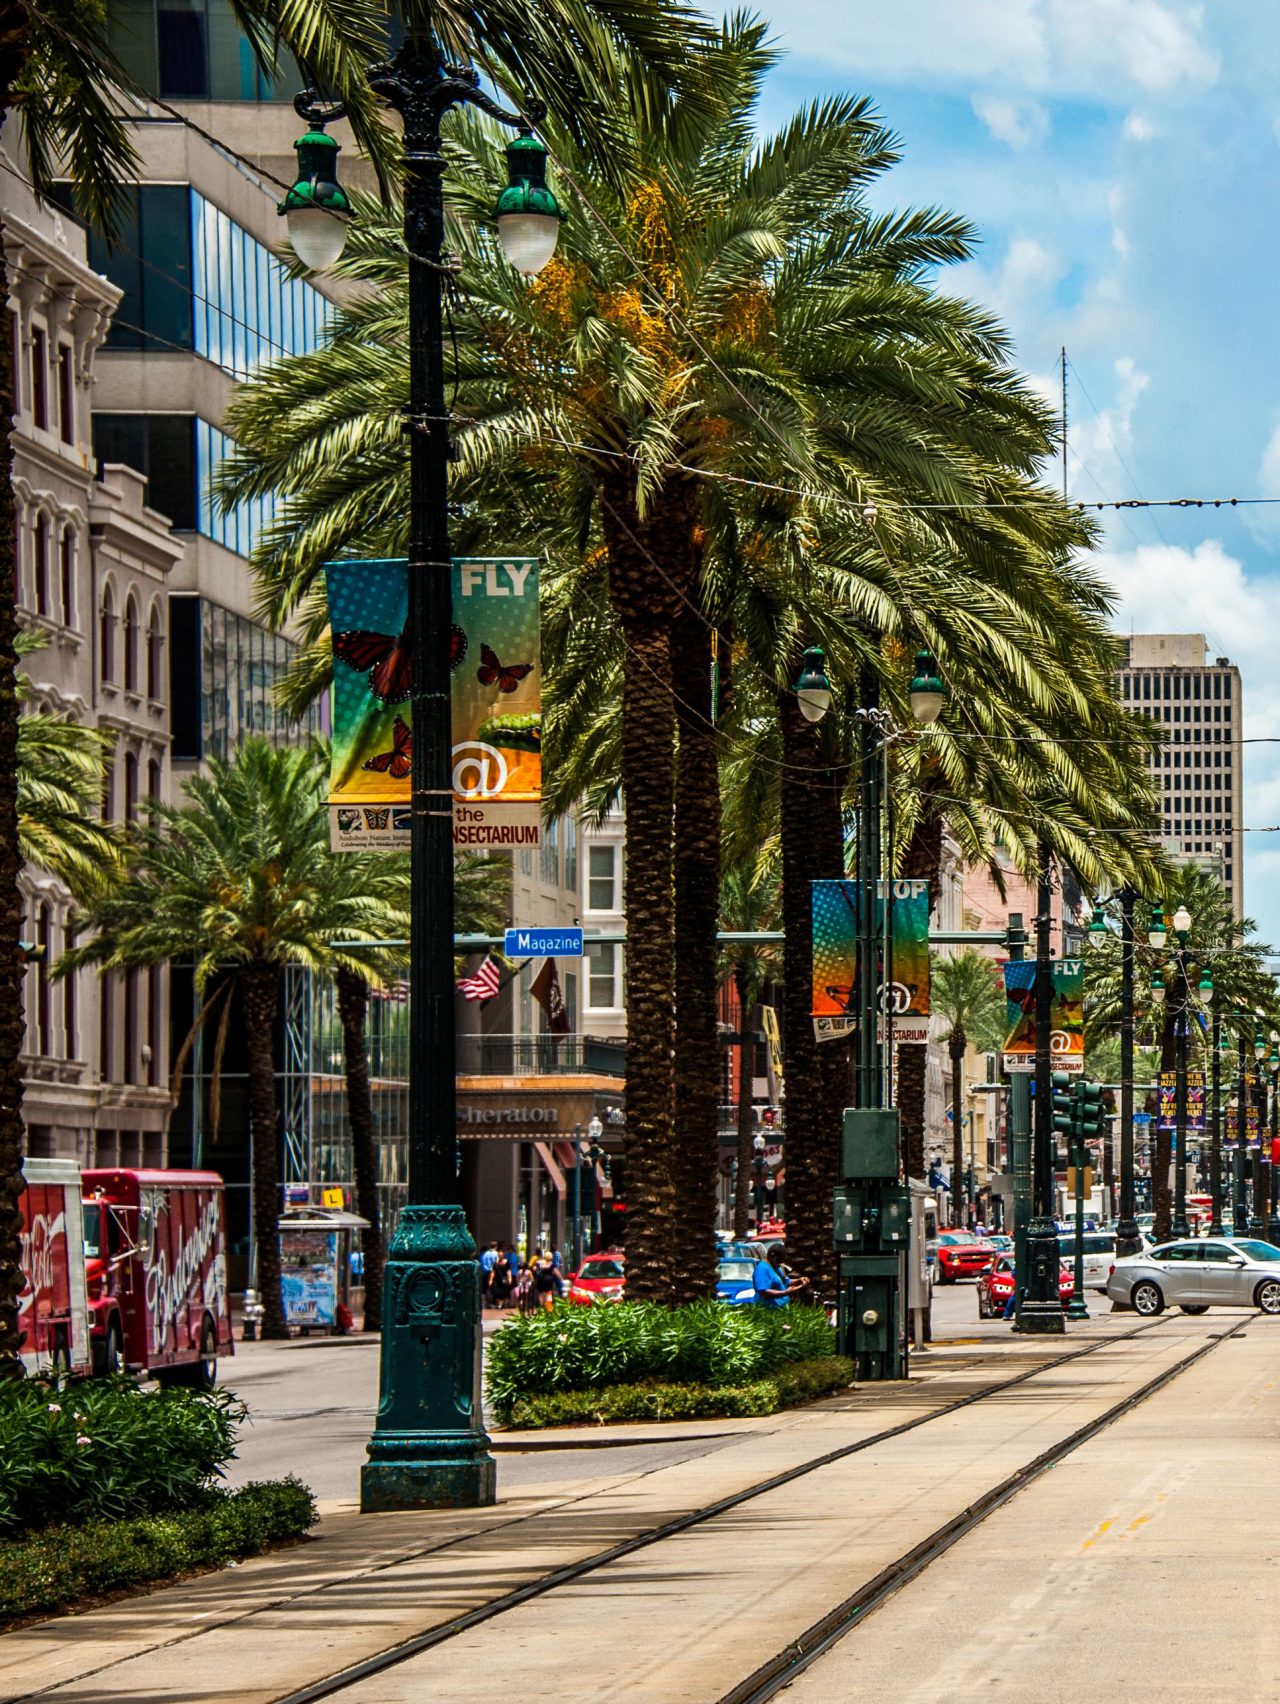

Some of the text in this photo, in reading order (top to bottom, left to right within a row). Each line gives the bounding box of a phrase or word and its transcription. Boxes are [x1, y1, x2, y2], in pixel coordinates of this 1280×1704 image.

[461, 563, 532, 596] FLY
[456, 807, 484, 821] the
[452, 825, 538, 844] NSECTARIUM
[518, 933, 580, 954] Magazine
[1054, 962, 1081, 975] FLY
[1051, 1063, 1082, 1072] SECTARIUM
[456, 1105, 558, 1124] Sheraton
